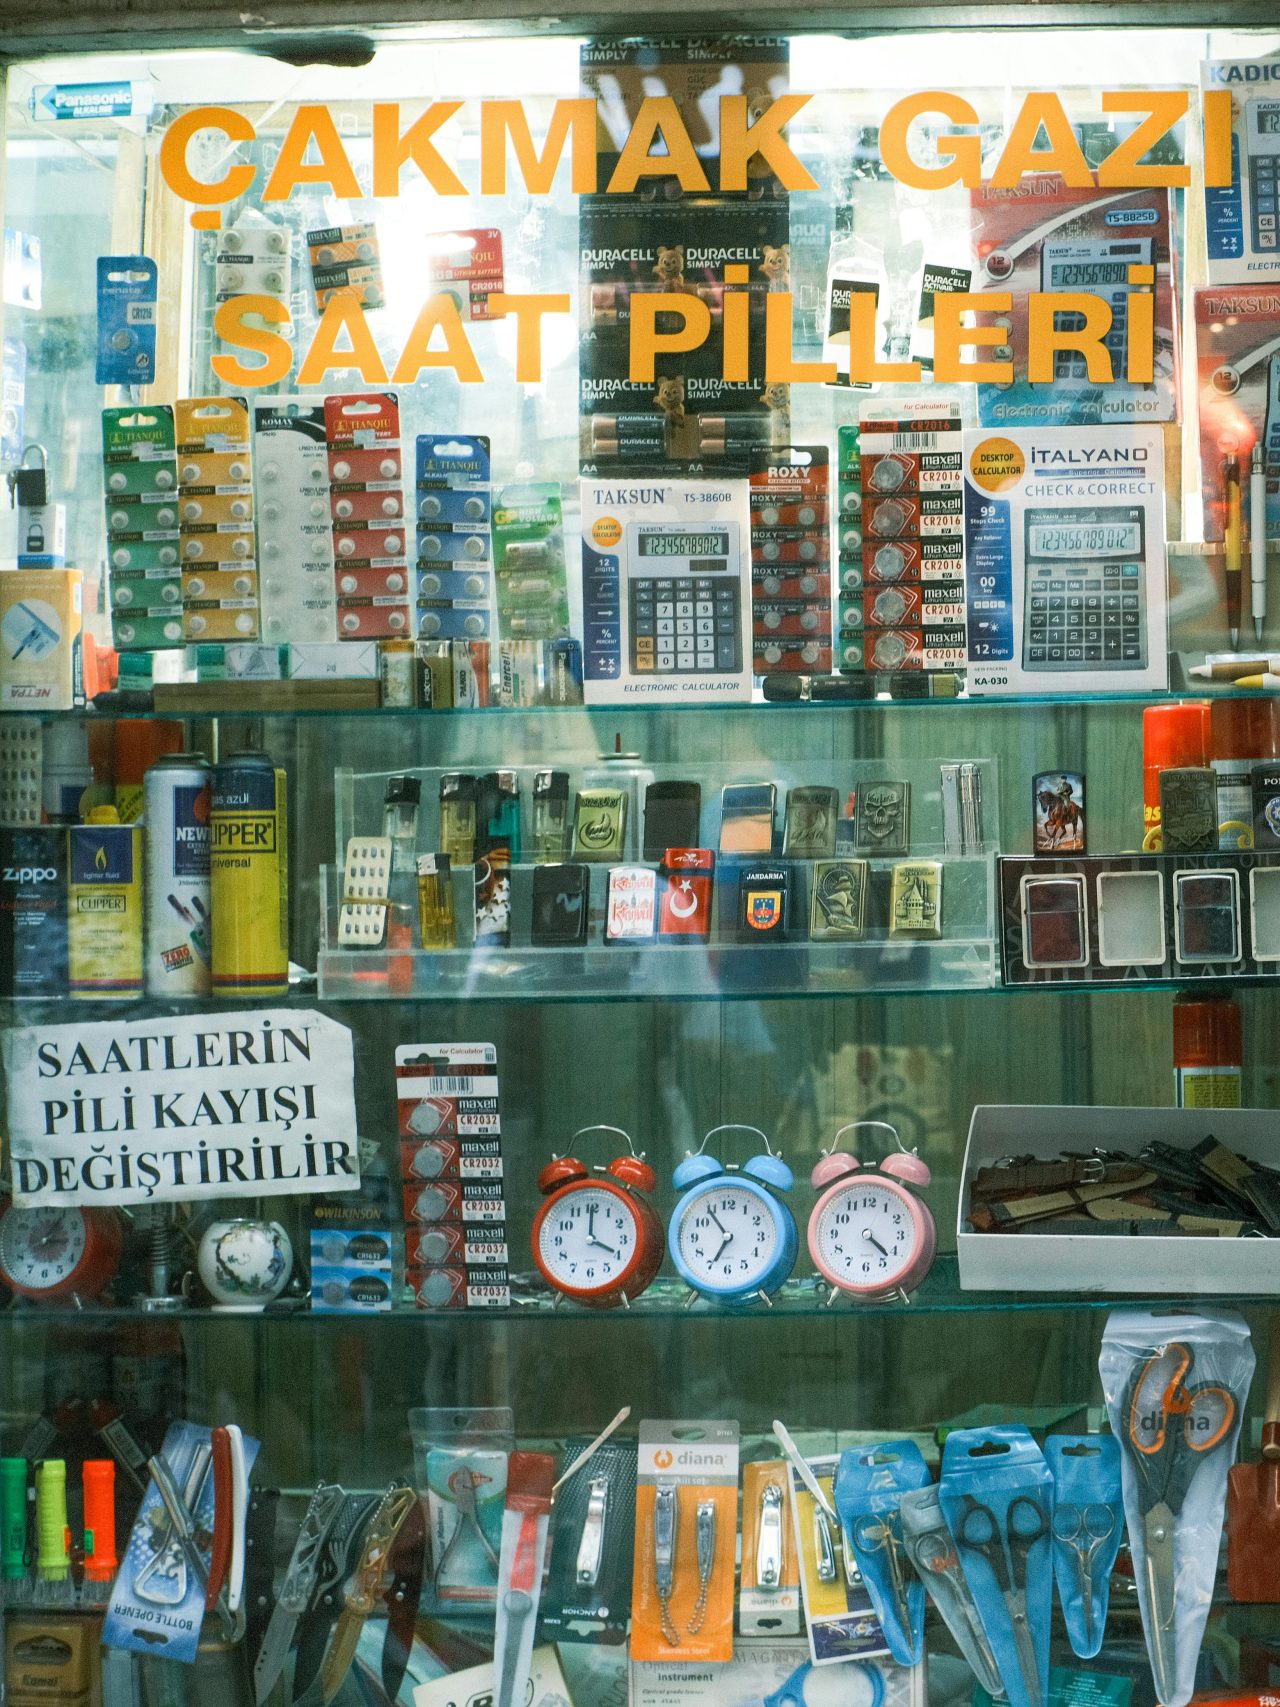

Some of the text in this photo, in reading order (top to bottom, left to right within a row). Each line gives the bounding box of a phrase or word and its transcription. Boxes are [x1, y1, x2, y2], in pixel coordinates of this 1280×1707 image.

[582, 50, 627, 61] SIMPLY
[55, 89, 132, 107] Panasonic
[159, 90, 1233, 230] ÇAKMAK GAZI
[307, 229, 341, 242] maxell
[487, 230, 499, 239] 3V
[582, 248, 655, 261] DURACELL
[687, 247, 761, 261] DURACELL
[582, 260, 616, 270] SIMPLY
[687, 260, 721, 269] SIMPLY
[313, 271, 347, 285] maxell
[924, 273, 969, 289] DURACELL
[471, 281, 503, 292] CR2016
[131, 306, 153, 320] CR1216
[210, 264, 1155, 388] SAAT PİLLERİ
[582, 332, 598, 341] AA
[582, 378, 655, 392] DURACELL
[688, 377, 762, 391] DURACELL
[582, 391, 616, 400] SIMPLY
[688, 390, 722, 399] SIMPLY
[903, 403, 949, 411] for Calculator
[992, 401, 1071, 419] Electronic
[261, 418, 293, 427] KOMAX
[349, 418, 391, 430] TIANQIU
[910, 420, 951, 431] CR2016
[126, 431, 165, 442] TIANQIU
[922, 453, 960, 466] maxell
[980, 453, 1015, 463] DESKTOP
[1031, 446, 1148, 464] İTALYANO
[440, 460, 481, 470] TIANQIU
[582, 463, 598, 473] AA
[688, 463, 704, 472] AA
[767, 466, 811, 479] ROXY
[922, 471, 960, 482] CR2016
[973, 466, 1021, 476] CALCULATOR
[1025, 483, 1074, 497] CHECK
[1087, 481, 1156, 496] CORRECT
[593, 488, 732, 505] TAKSUN TS-3860B
[923, 497, 961, 510] maxell
[980, 506, 996, 517] 99
[494, 510, 518, 525] GP
[519, 513, 559, 523] VOLTAGE
[923, 515, 961, 526] CR2016
[752, 531, 777, 539] ROXY
[923, 542, 961, 554] maxell
[599, 558, 610, 567] 12
[924, 560, 962, 571] CR2016
[753, 567, 778, 575] ROXY
[979, 576, 996, 587] 00
[924, 587, 963, 599] maxell
[753, 604, 779, 612] ROXY
[925, 604, 963, 615] CR2016
[925, 631, 964, 643] maxell
[754, 641, 779, 649] ROXY
[974, 644, 990, 655] 12
[926, 649, 964, 660] CR2016
[502, 650, 512, 694] Enercell
[557, 651, 568, 702] Panasonic
[624, 682, 740, 692] ELECTRONIC CALCULATOR
[974, 677, 1008, 686] KA-030
[211, 822, 268, 846] IPPER
[2, 866, 57, 884] zippo
[746, 871, 785, 881] JANDARMA
[81, 898, 121, 910] CLIPPER
[163, 946, 190, 965] ZERO
[38, 1019, 312, 1079] SAATLERİN
[450, 1047, 484, 1055] Calculator
[459, 1098, 497, 1109] maxell
[43, 1083, 319, 1136] PİLİ KAYIŞI
[460, 1115, 497, 1125] CR2032
[461, 1141, 499, 1153] maxell
[17, 1132, 357, 1198] DEĞİŞTİRİLİR
[462, 1158, 500, 1169] CR2032
[464, 1184, 501, 1196] maxell
[465, 1201, 502, 1212] CR2032
[721, 1199, 736, 1211] 12
[847, 1200, 858, 1211] 11
[862, 1197, 877, 1208] 12
[323, 1207, 382, 1219] WILKINSON
[570, 1207, 581, 1217] 11
[695, 1217, 710, 1228] 10
[835, 1213, 850, 1224] 10
[892, 1214, 901, 1224] 2
[559, 1220, 573, 1231] 10
[466, 1227, 504, 1239] maxell
[830, 1229, 839, 1239] 9
[896, 1230, 905, 1241] 3
[467, 1243, 505, 1255] CR2032
[834, 1244, 843, 1254] 8
[889, 1245, 898, 1256] 4
[844, 1256, 853, 1267] 7
[878, 1258, 887, 1268] 5
[861, 1262, 870, 1273] 6
[469, 1270, 507, 1282] maxell
[470, 1286, 507, 1297] CR2032
[1141, 1410, 1210, 1431] dina
[677, 1450, 725, 1466] diana
[750, 1598, 779, 1607] diana
[114, 1603, 194, 1631] BOTTLE OPENER
[561, 1607, 597, 1616] ANCHOR
[657, 1645, 711, 1655] Stainless Steel
[657, 1673, 714, 1682] Instrument
